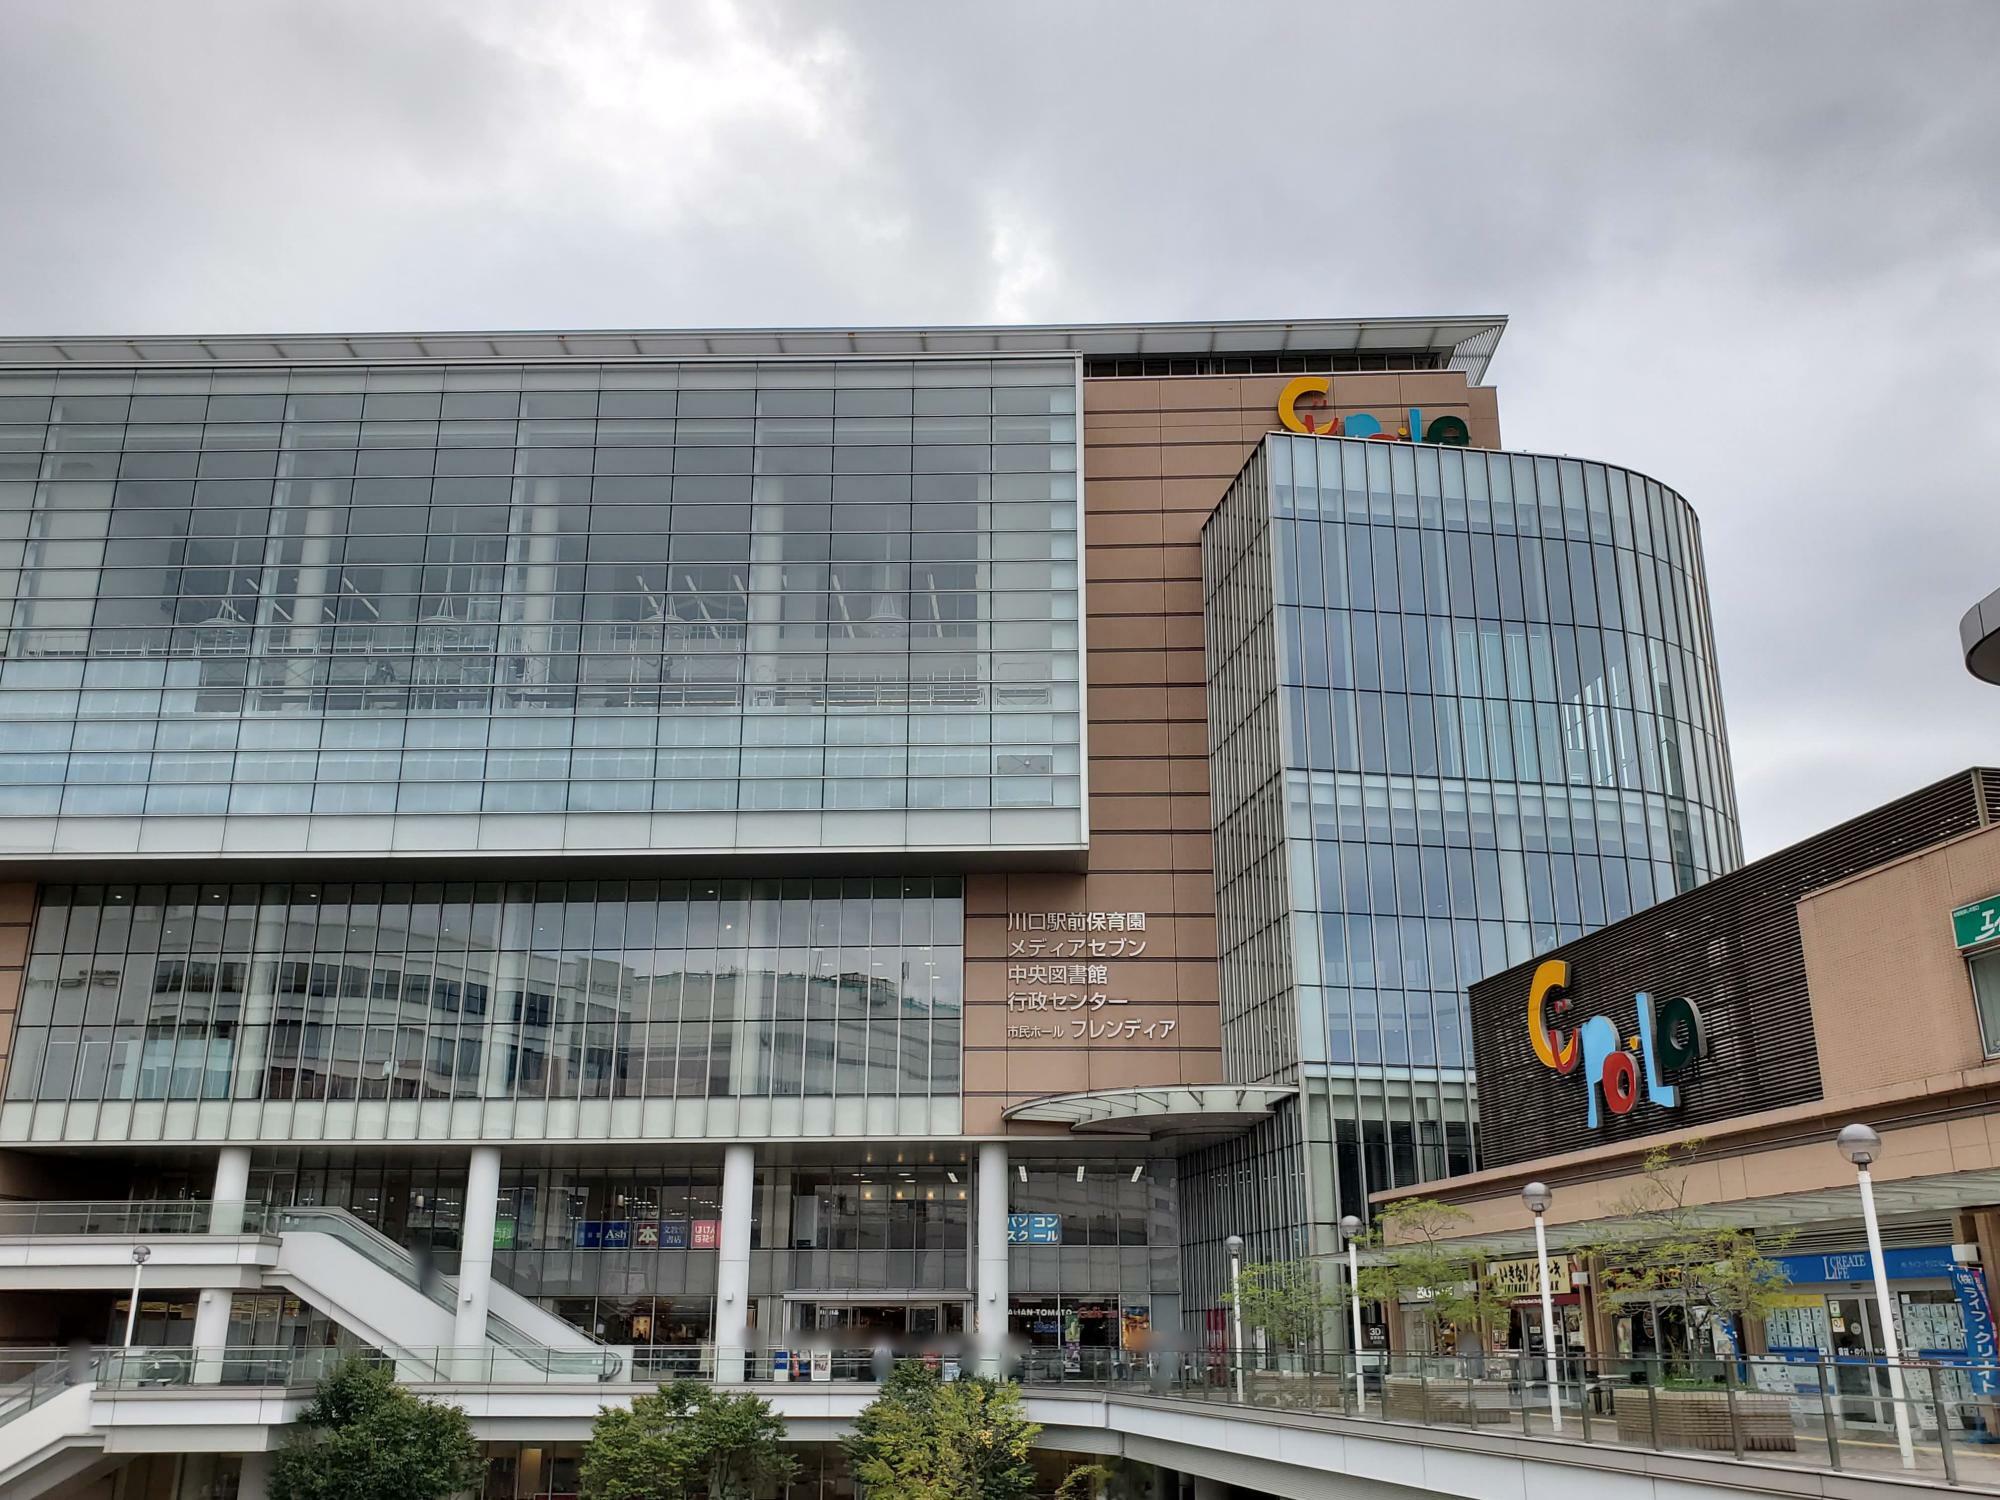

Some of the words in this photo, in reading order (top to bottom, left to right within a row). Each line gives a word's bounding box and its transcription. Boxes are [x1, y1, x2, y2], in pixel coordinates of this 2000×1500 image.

[1008, 912, 1146, 932] 川口駅前保育園
[1008, 938, 1146, 957] メディアセブン
[1008, 965, 1108, 985] 中央図書館
[1008, 992, 1128, 1011] 行政センター
[1008, 1025, 1064, 1038] 市民ホール
[1071, 1020, 1176, 1039] フレンディア
[605, 1229, 627, 1239] Ash
[638, 1226, 658, 1243] 本
[1008, 1230, 1059, 1241] スクール
[1369, 1327, 1381, 1336] 3D
